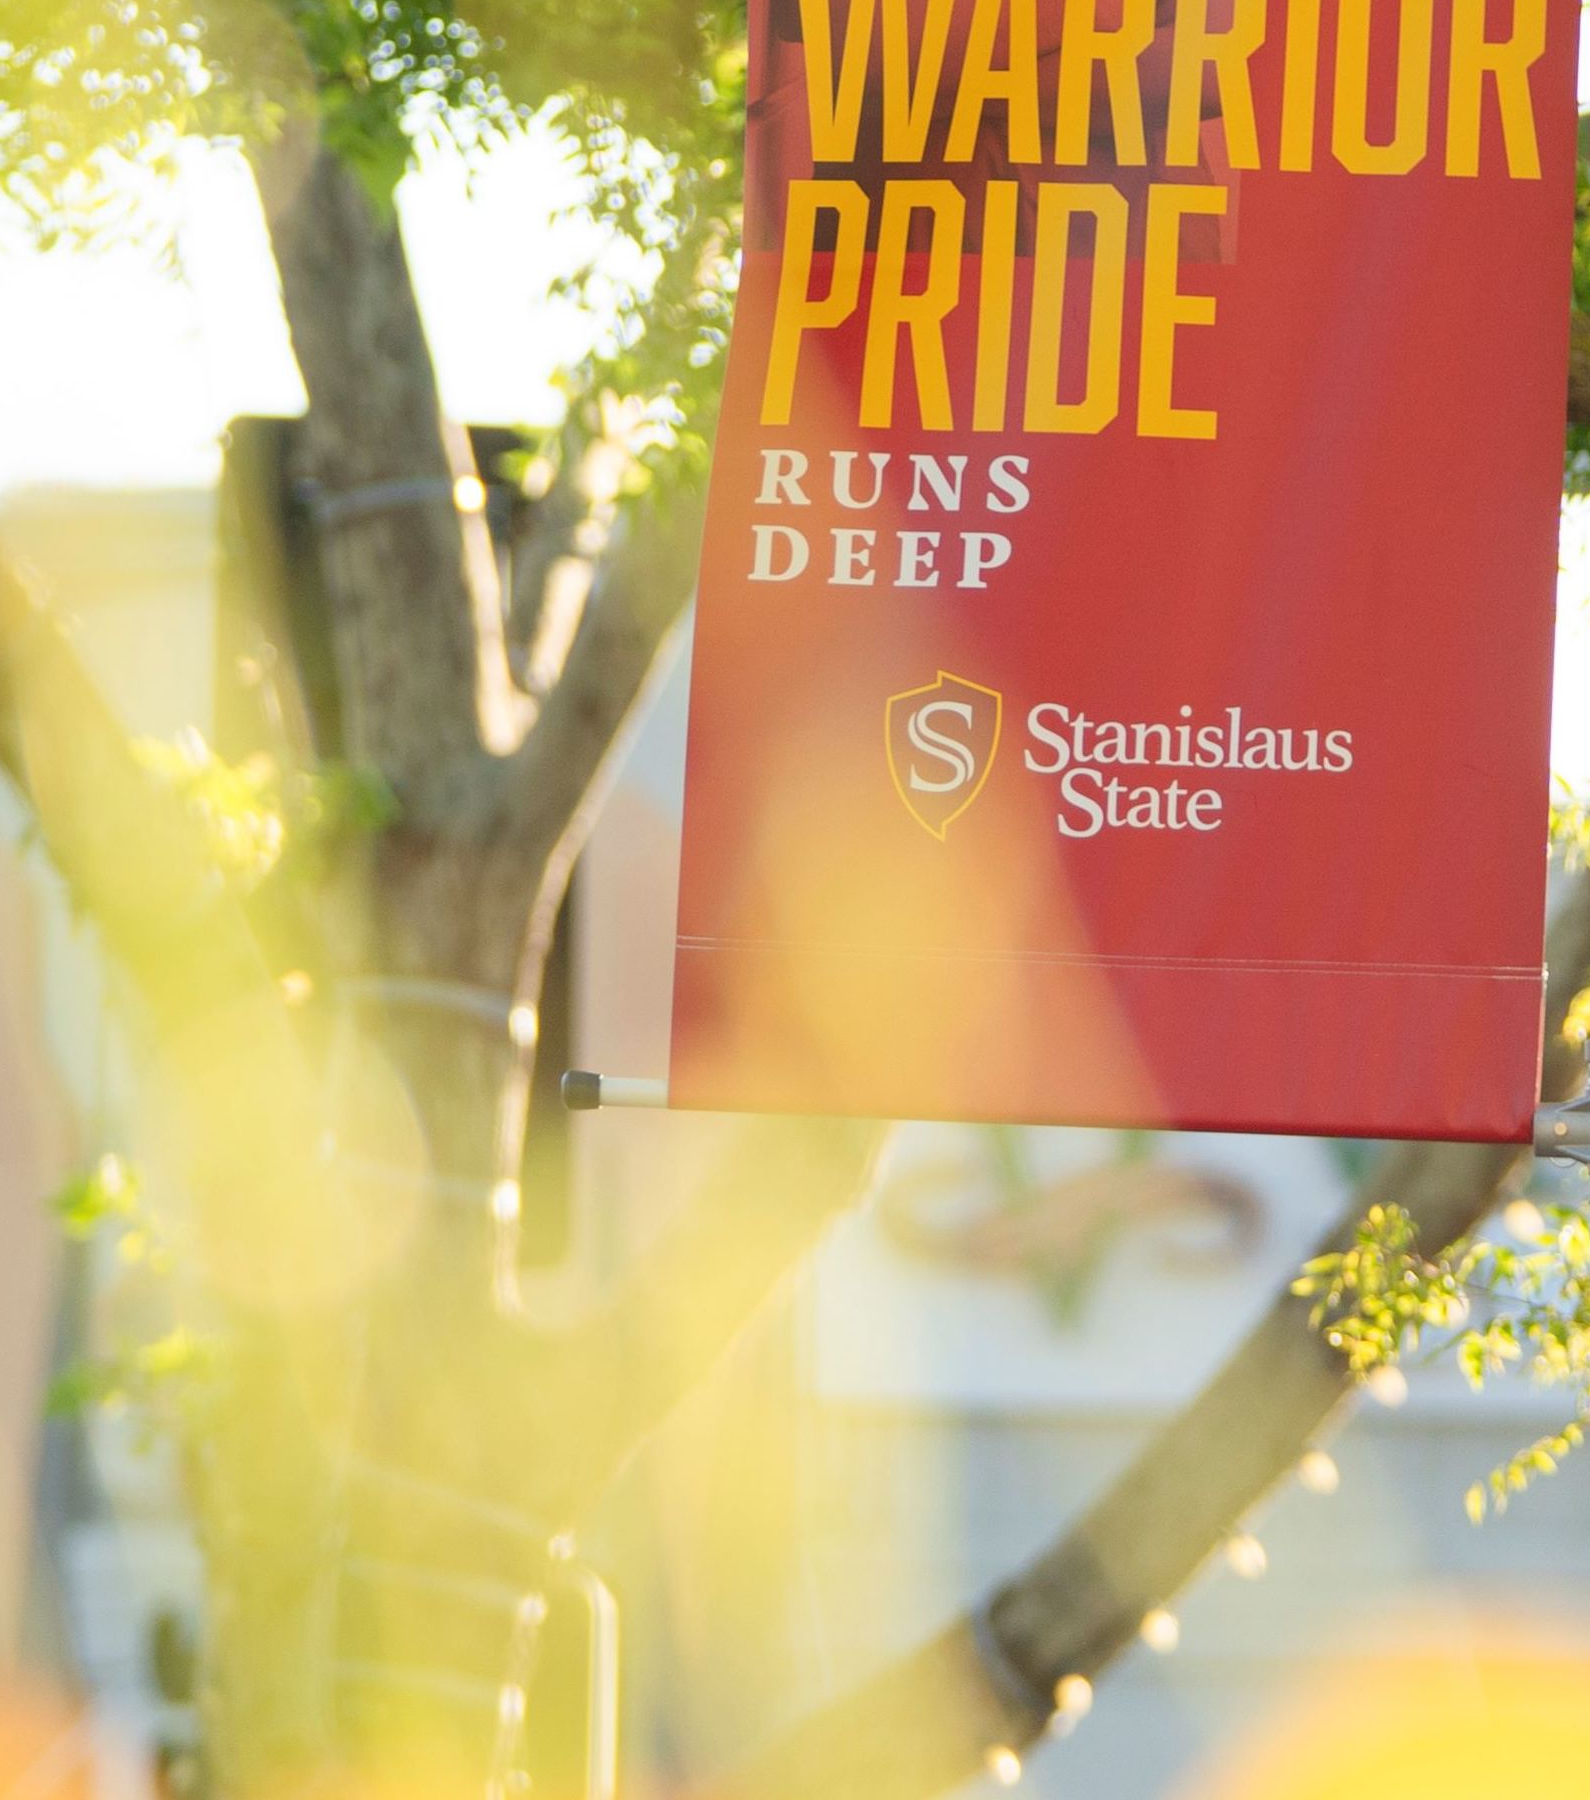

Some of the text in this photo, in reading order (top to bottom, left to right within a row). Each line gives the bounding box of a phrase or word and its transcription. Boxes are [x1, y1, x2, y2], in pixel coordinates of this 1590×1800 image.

[760, 179, 1228, 440] PRIDE
[754, 449, 1032, 513] RUNS
[748, 523, 1012, 588] DEEP
[908, 701, 1353, 793] S Stanislaus
[1058, 768, 1222, 838] State
